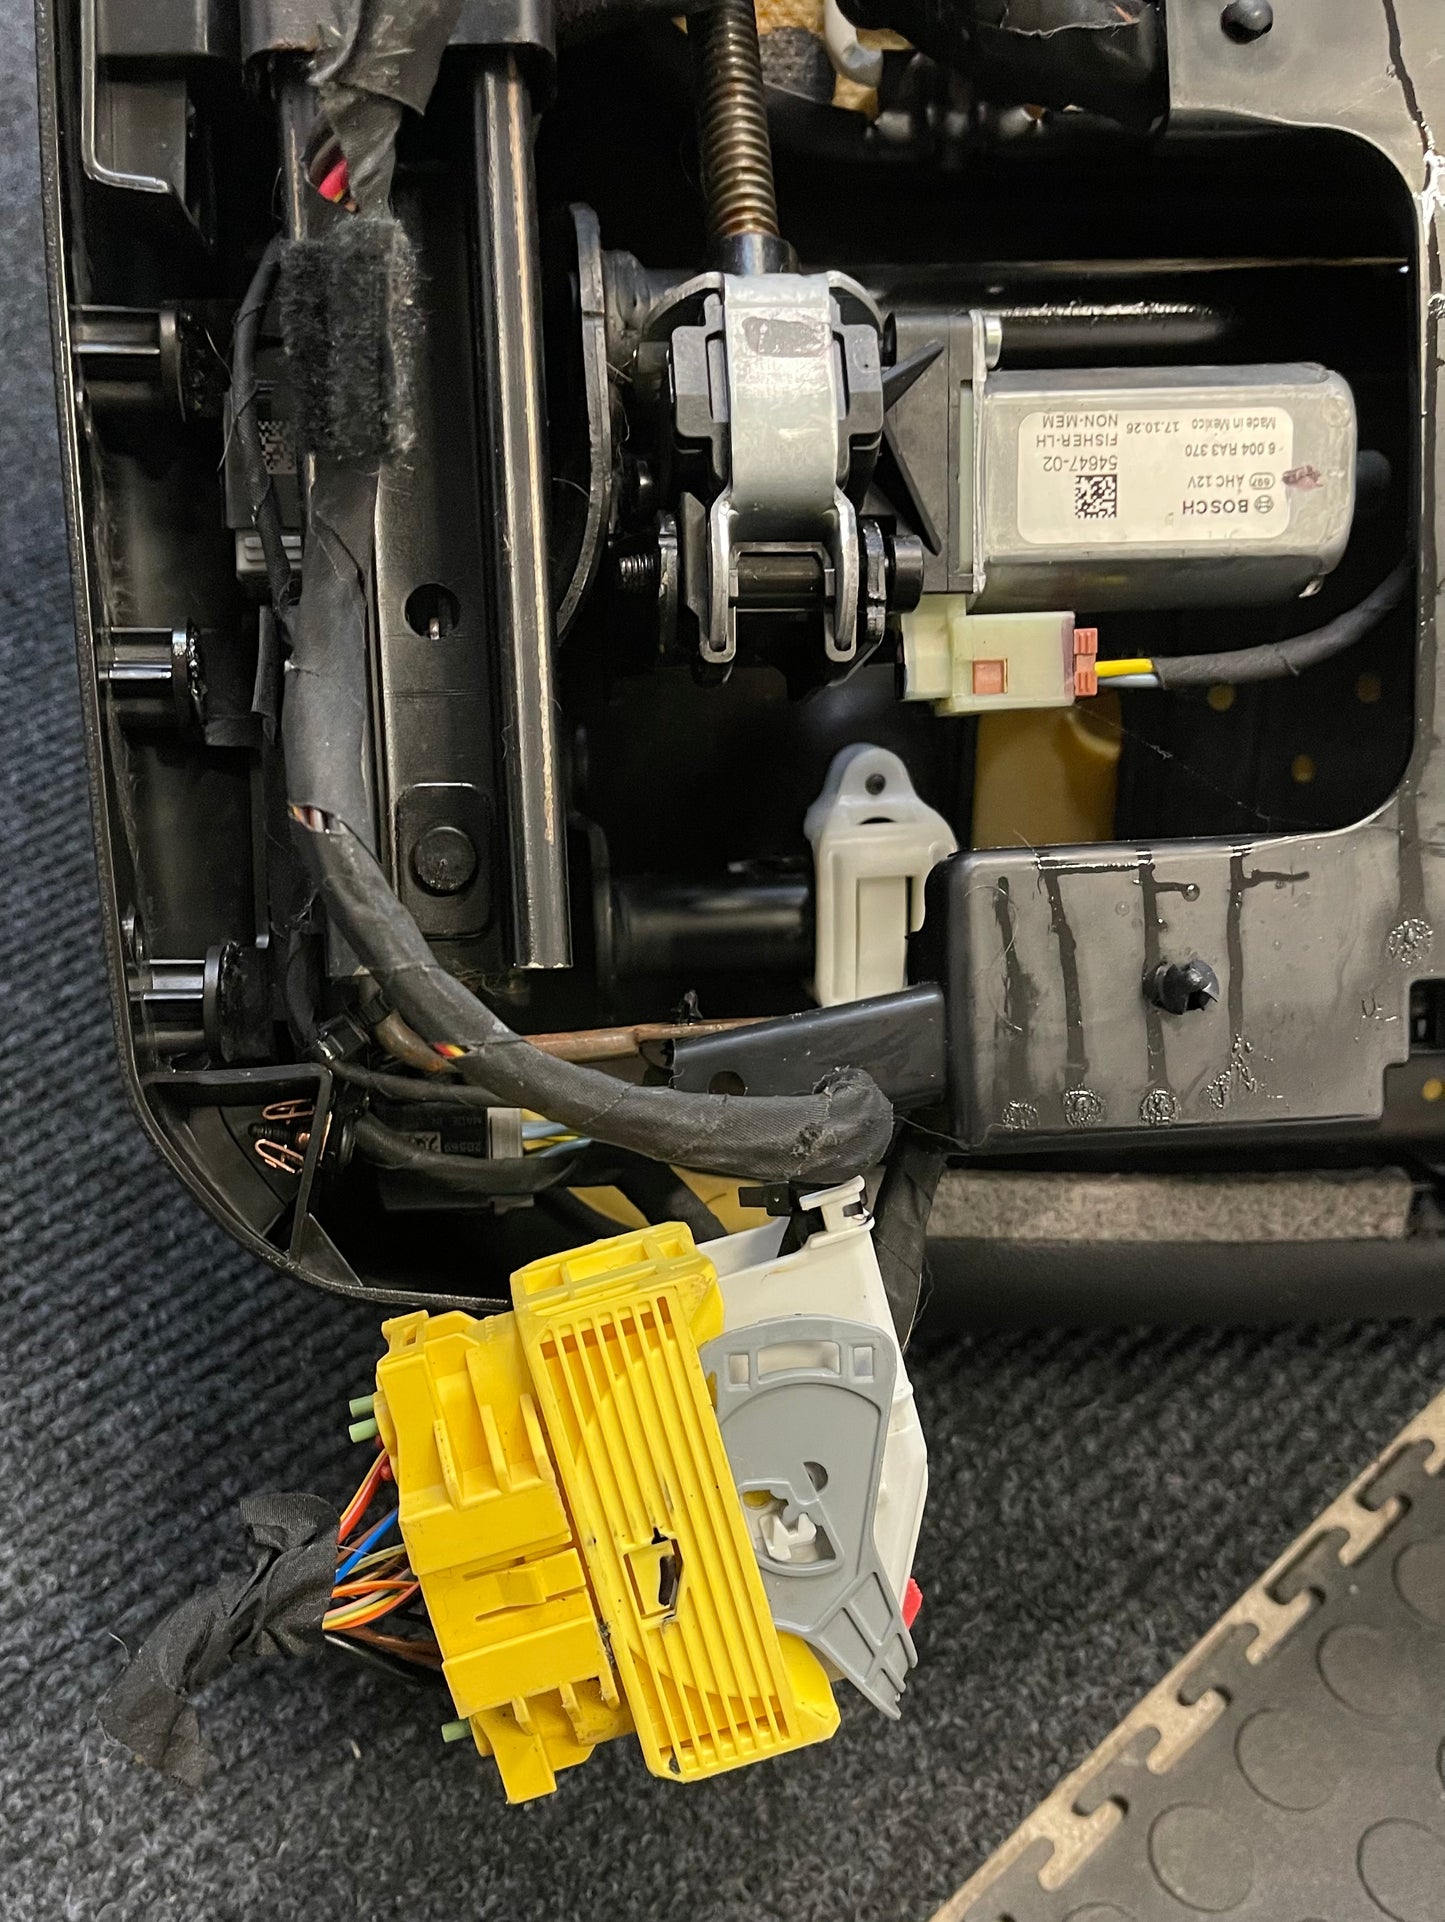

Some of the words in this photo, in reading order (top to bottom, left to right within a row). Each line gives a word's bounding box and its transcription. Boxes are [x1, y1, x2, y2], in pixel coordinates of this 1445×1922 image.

[1126, 421, 1180, 434] 17.10.26
[1191, 418, 1230, 431] Mexico
[1233, 418, 1244, 431] in
[1246, 417, 1276, 430] Made
[1184, 444, 1208, 457] 370
[1211, 443, 1238, 456] RA3
[1241, 443, 1264, 456] 004
[1268, 442, 1276, 455] 6
[1043, 455, 1118, 472] 54647-02
[1187, 475, 1211, 489] 12V
[1182, 499, 1249, 515] BOSCH
